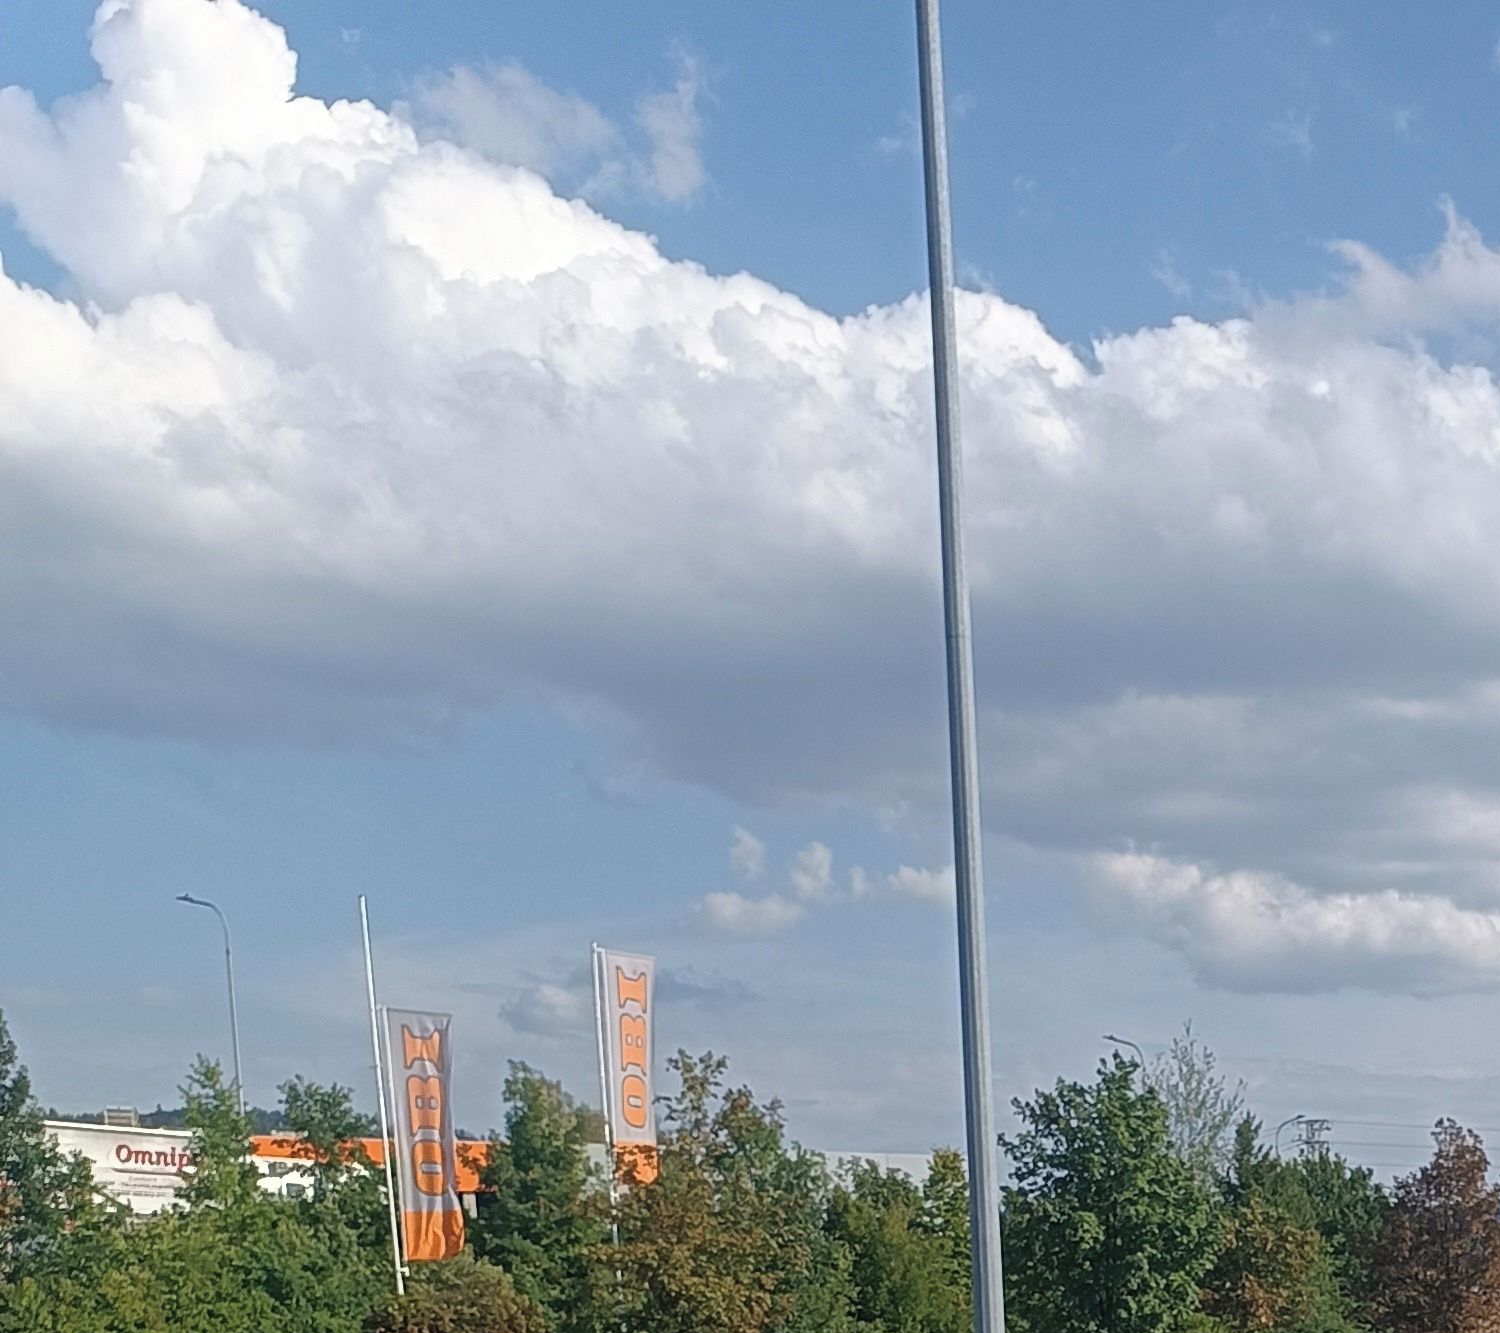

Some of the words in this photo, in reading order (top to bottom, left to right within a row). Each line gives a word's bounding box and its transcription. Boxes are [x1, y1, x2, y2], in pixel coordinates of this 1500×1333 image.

[401, 1024, 445, 1196] OBI
[615, 965, 648, 1129] OBI
[115, 1144, 194, 1174] Omnip
